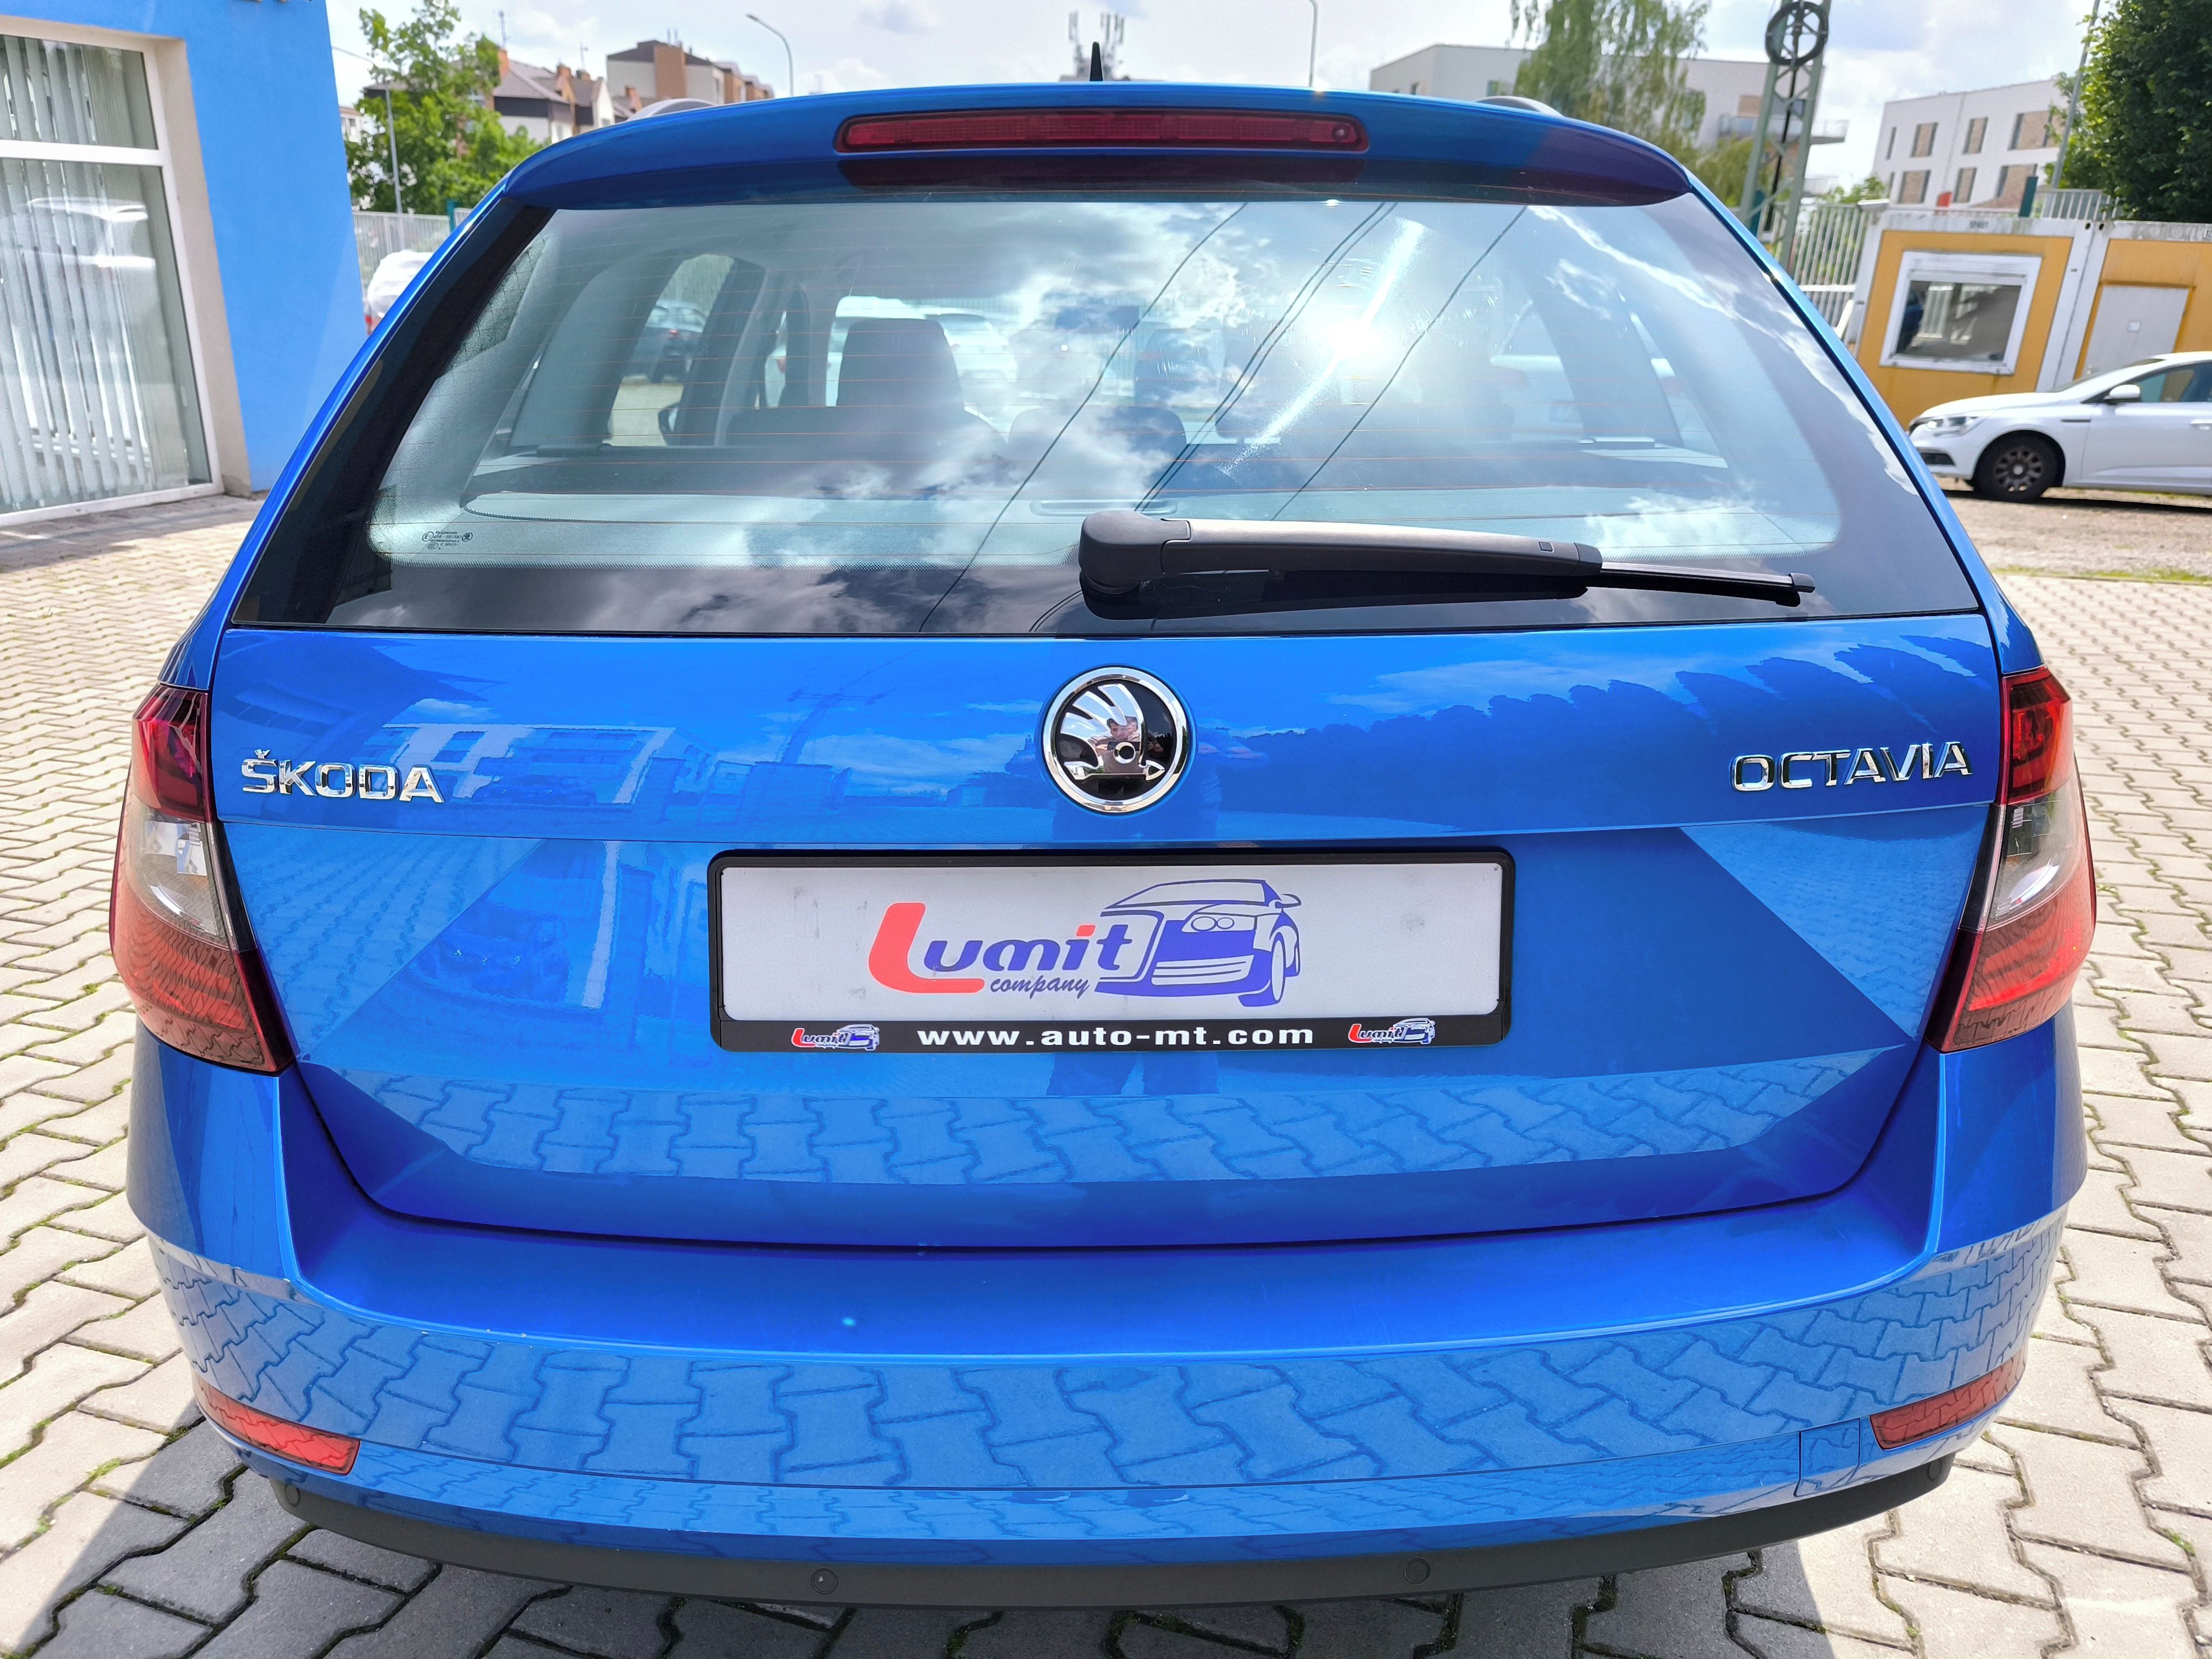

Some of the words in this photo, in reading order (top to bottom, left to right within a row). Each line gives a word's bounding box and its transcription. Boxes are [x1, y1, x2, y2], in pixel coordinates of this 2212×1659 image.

[241, 748, 445, 803] ŠKODA
[1730, 741, 1973, 792] OCTAVIA
[868, 902, 1132, 993] Lumit
[990, 975, 1089, 1000] company
[791, 1028, 845, 1047] Lumit
[916, 1026, 1313, 1046] www.auto-mt.com
[1348, 1024, 1401, 1043] Lumit
